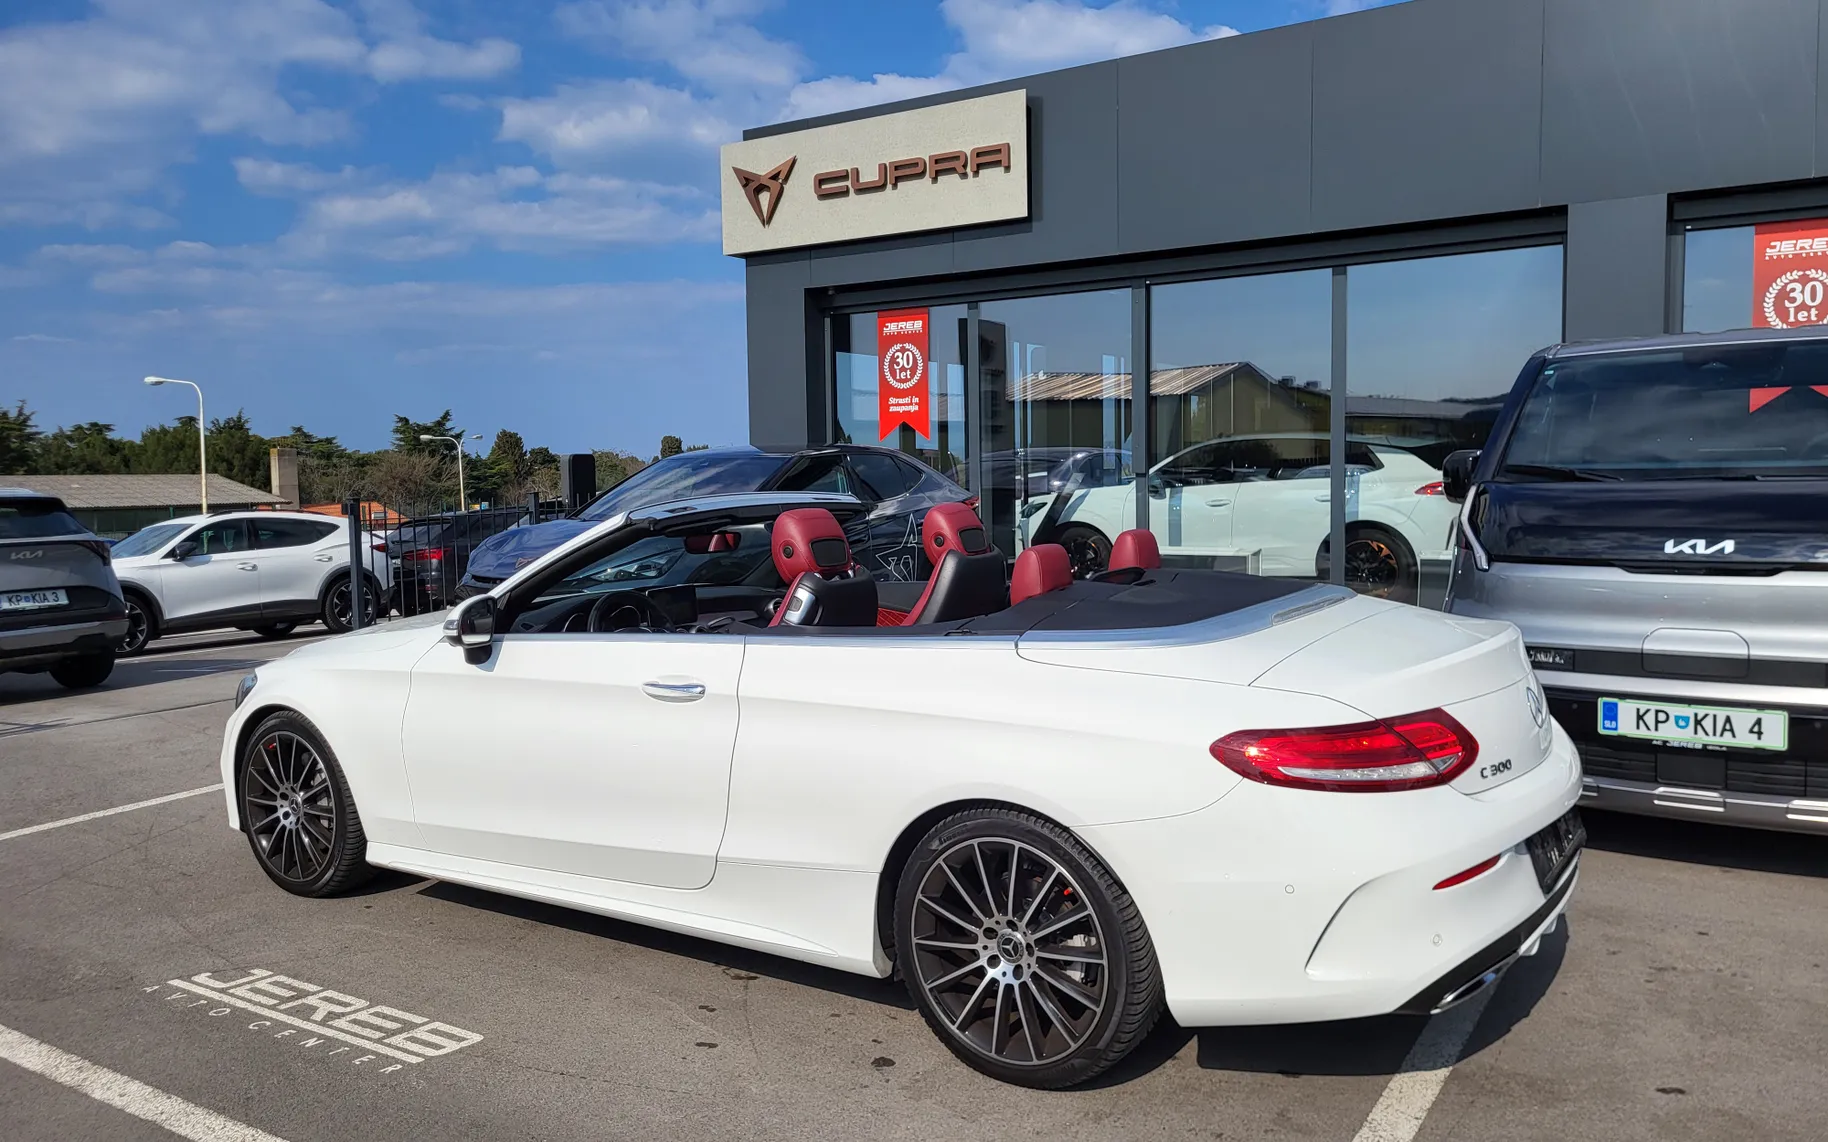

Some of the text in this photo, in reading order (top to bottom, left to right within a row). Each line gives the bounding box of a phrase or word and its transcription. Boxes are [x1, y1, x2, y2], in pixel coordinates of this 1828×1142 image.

[813, 142, 1011, 200] CUPRA
[1765, 237, 1828, 252] JERE
[1784, 281, 1823, 308] 30
[1788, 307, 1818, 322] let
[883, 320, 922, 331] JEREB
[893, 351, 913, 369] 30
[896, 369, 911, 379] let
[888, 396, 911, 404] Strasti
[889, 403, 919, 413] zaupanja
[1664, 538, 1735, 555] KIA
[7, 591, 60, 606] KP KIA 3
[1635, 707, 1764, 741] KP KIA 4
[1480, 758, 1512, 779] C 300
[190, 968, 484, 1057] JEREB
[141, 985, 403, 1074] AVTO CENTER
